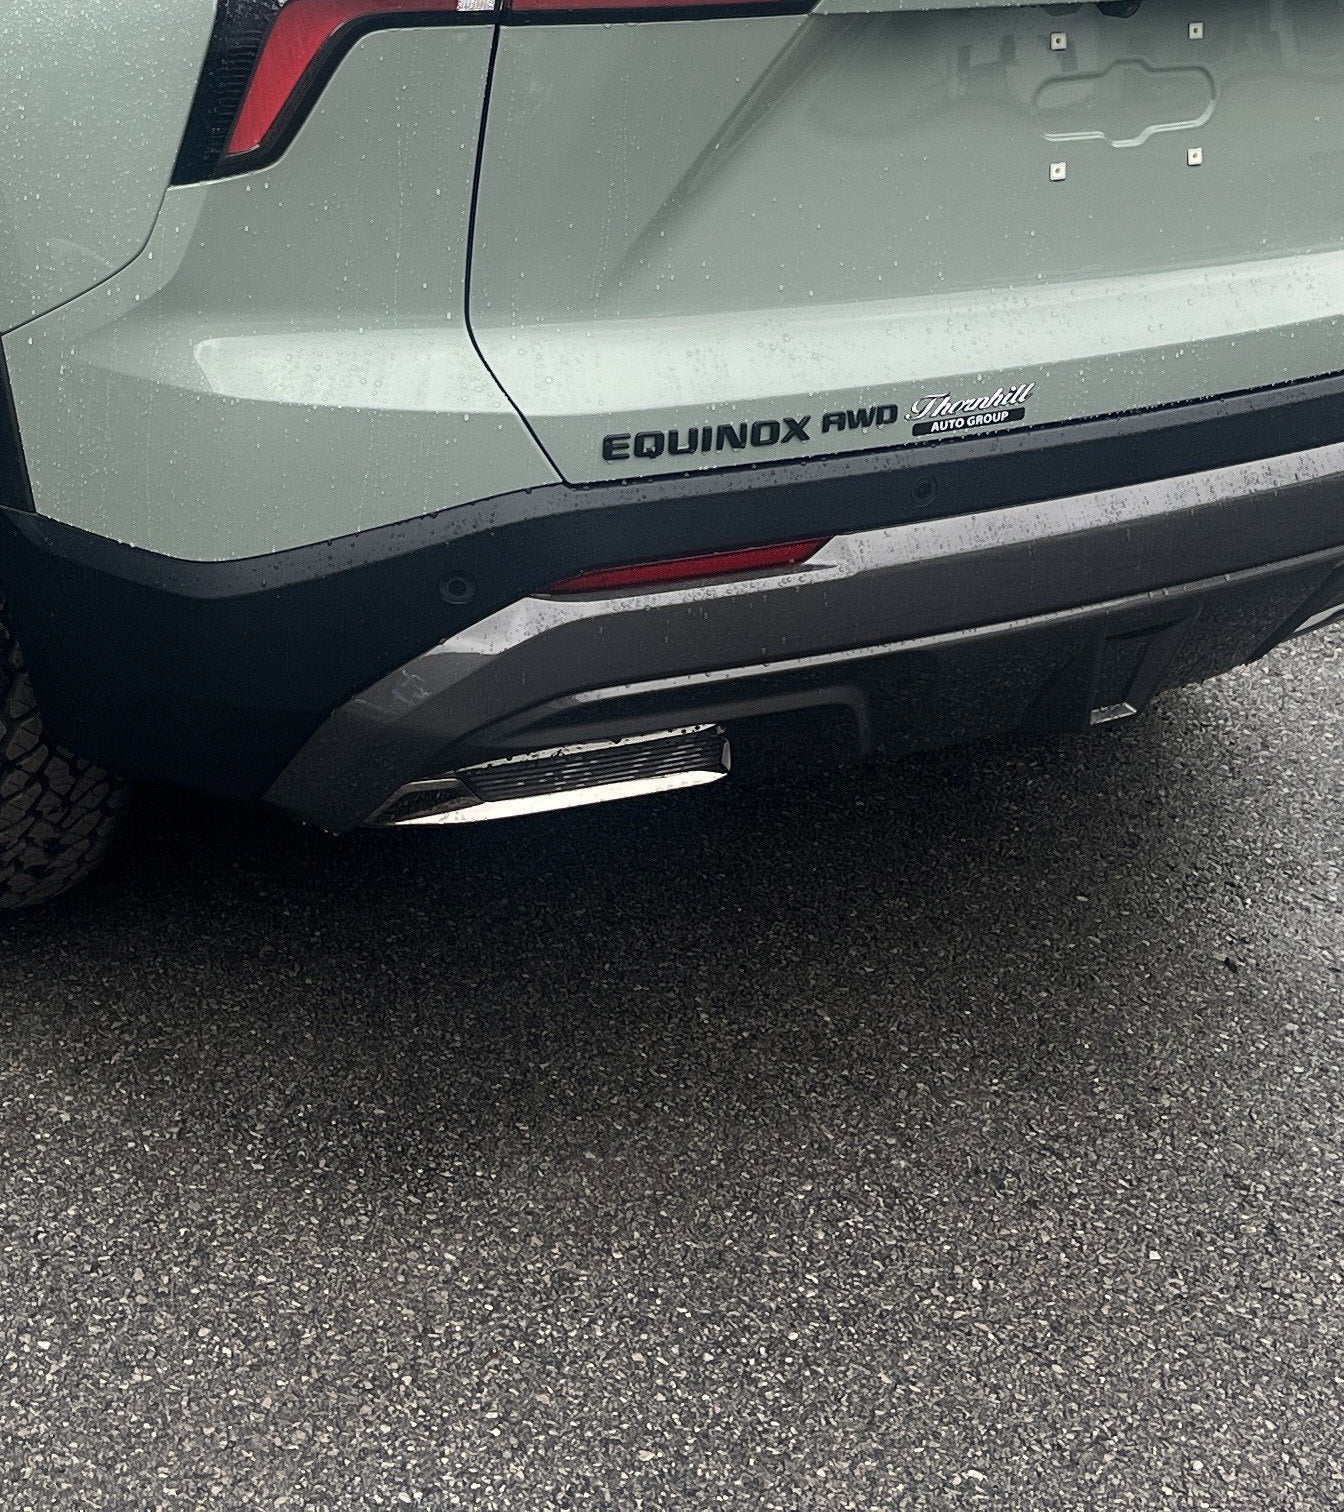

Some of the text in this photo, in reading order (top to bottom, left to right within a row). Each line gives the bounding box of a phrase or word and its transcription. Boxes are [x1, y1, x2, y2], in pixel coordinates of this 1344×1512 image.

[905, 382, 1036, 421] Thornhill
[601, 403, 898, 462] EQUINOX AWD
[930, 410, 1009, 433] AUTO GROUP
